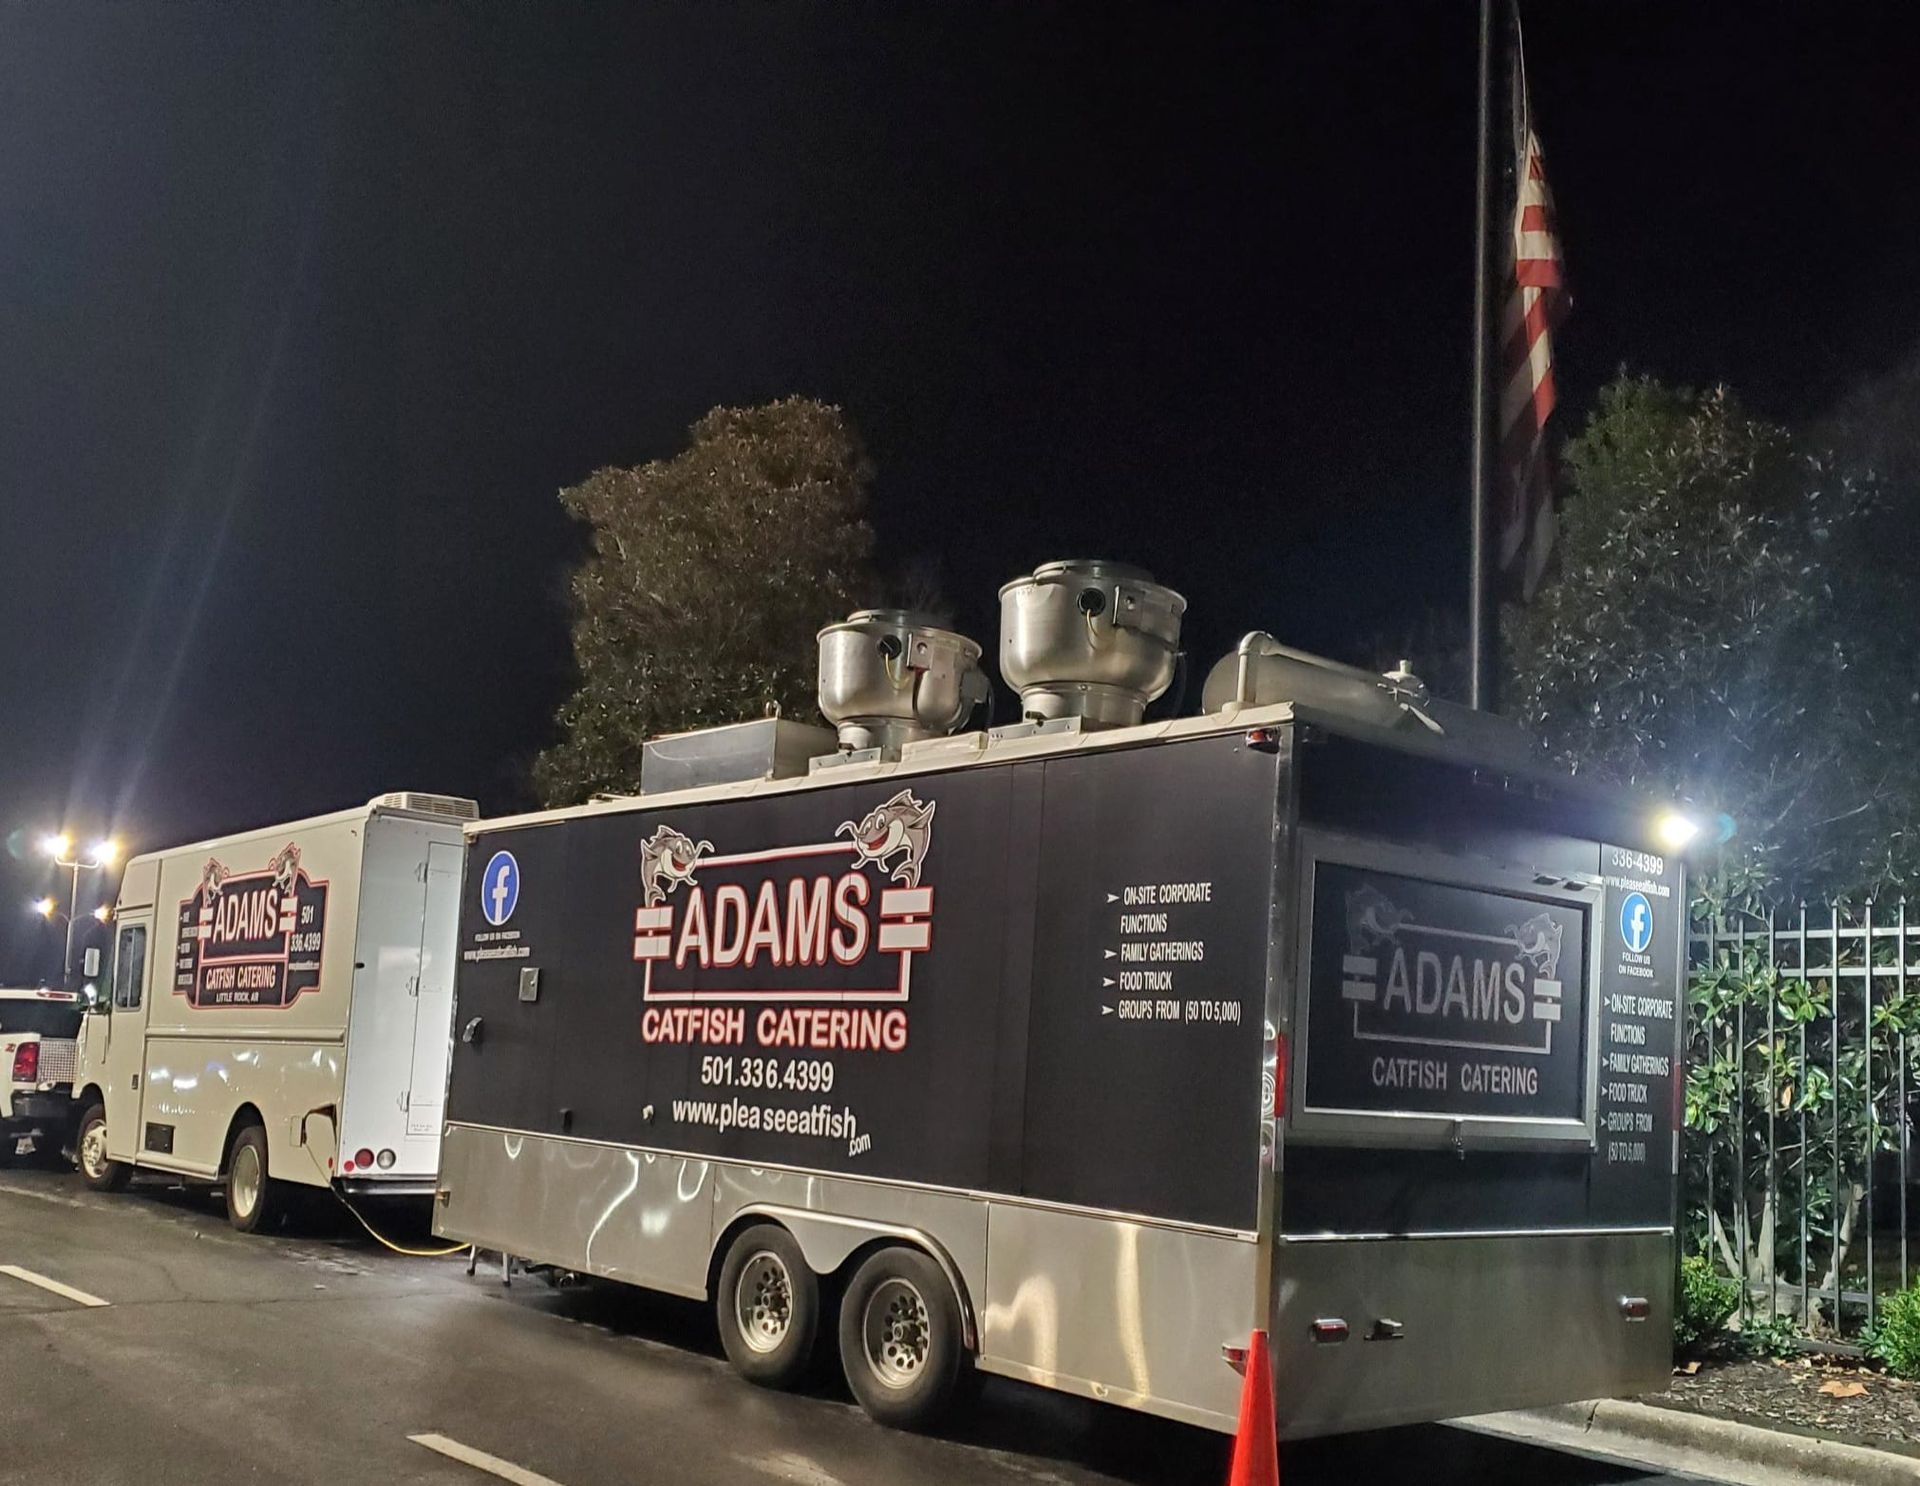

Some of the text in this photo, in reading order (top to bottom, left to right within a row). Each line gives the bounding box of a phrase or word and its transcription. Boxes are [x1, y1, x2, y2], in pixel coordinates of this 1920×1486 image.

[1612, 850, 1663, 875] 336-4399
[1124, 883, 1212, 905] ON-SITE CORPORATE
[213, 889, 278, 943] ADAMS
[301, 906, 314, 924] 501
[674, 873, 869, 968] ADAMS
[1120, 913, 1168, 934] FUNCTIONS
[291, 932, 321, 952] 336.4399
[1121, 942, 1204, 962] FAMILY GATHERINGS
[206, 967, 235, 990] CATFISH
[238, 965, 276, 989] CATERING
[1120, 971, 1173, 990] FOOD TRUCK
[1383, 947, 1526, 1024] ADAMS
[1118, 1000, 1241, 1025] GROUPS FROM (50 TO 5,000)
[1611, 993, 1673, 1019] ON-SITE CORPORATE
[641, 1007, 907, 1051] CATFISH CATERING
[1610, 1023, 1646, 1045] FUNCTIONS
[700, 1056, 834, 1092] 501.336.4399
[1372, 1057, 1538, 1095] CATFISH CATERING
[1609, 1052, 1669, 1076] FAMILY GATHERINGS
[1608, 1082, 1648, 1103] FOOD TRUCK
[1607, 1111, 1653, 1133] GROUPS FROM
